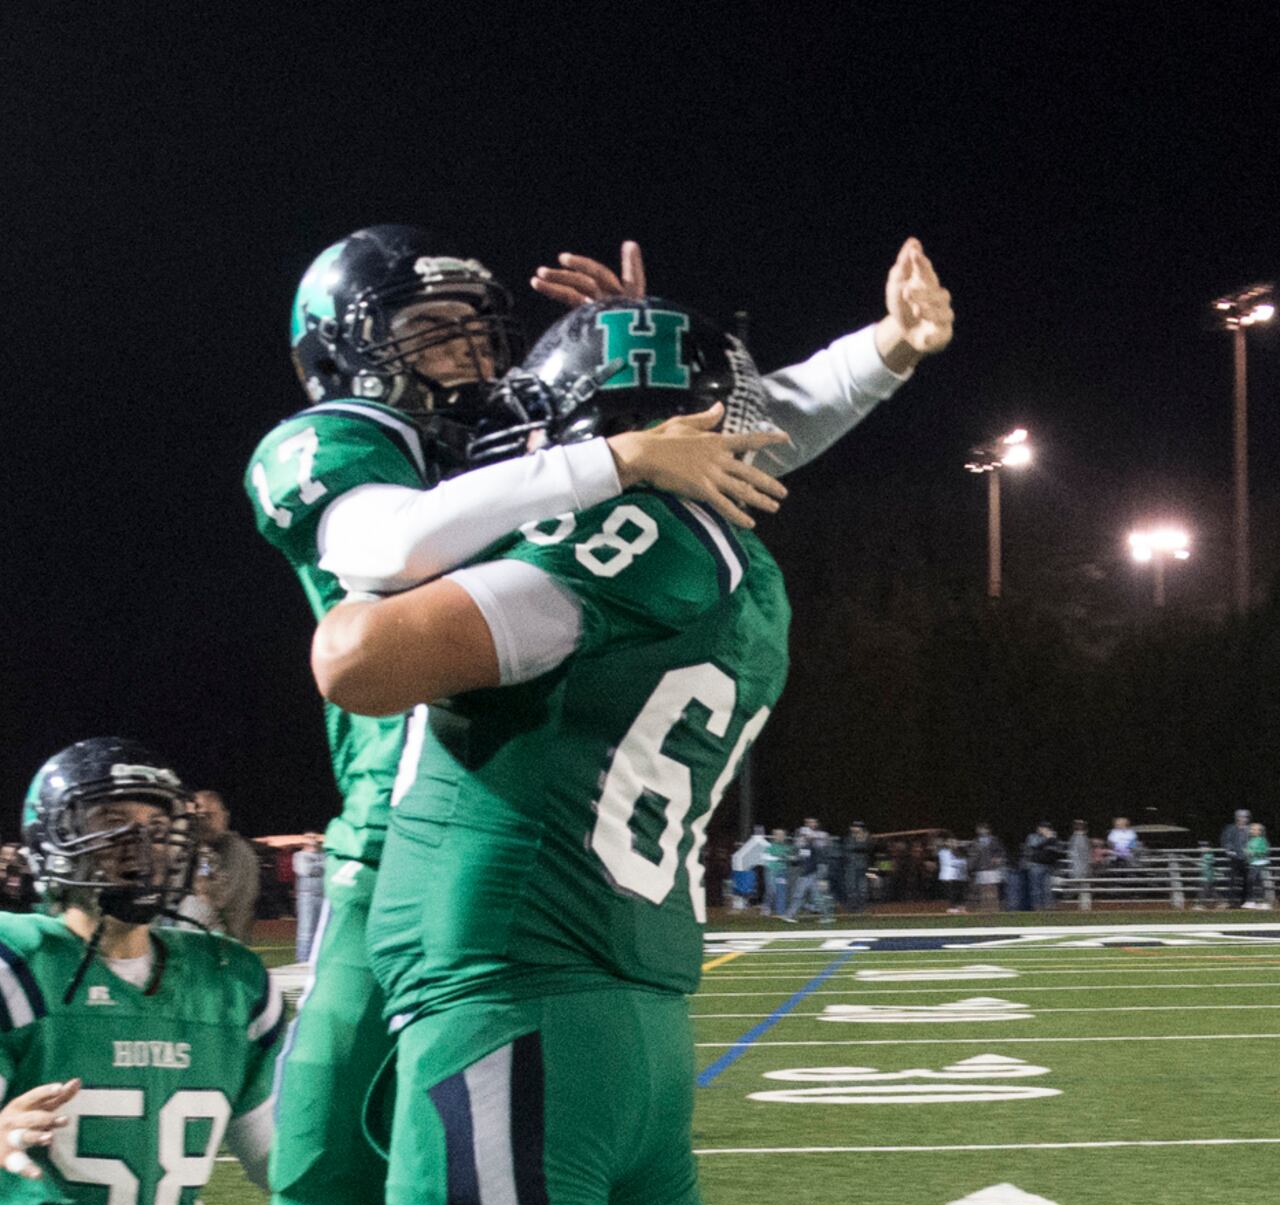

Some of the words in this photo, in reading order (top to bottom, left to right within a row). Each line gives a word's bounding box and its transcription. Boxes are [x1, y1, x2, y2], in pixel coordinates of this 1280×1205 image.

[596, 309, 690, 389] H
[252, 427, 327, 528] 17
[592, 661, 770, 924] 6
[112, 1040, 192, 1068] HOYAS
